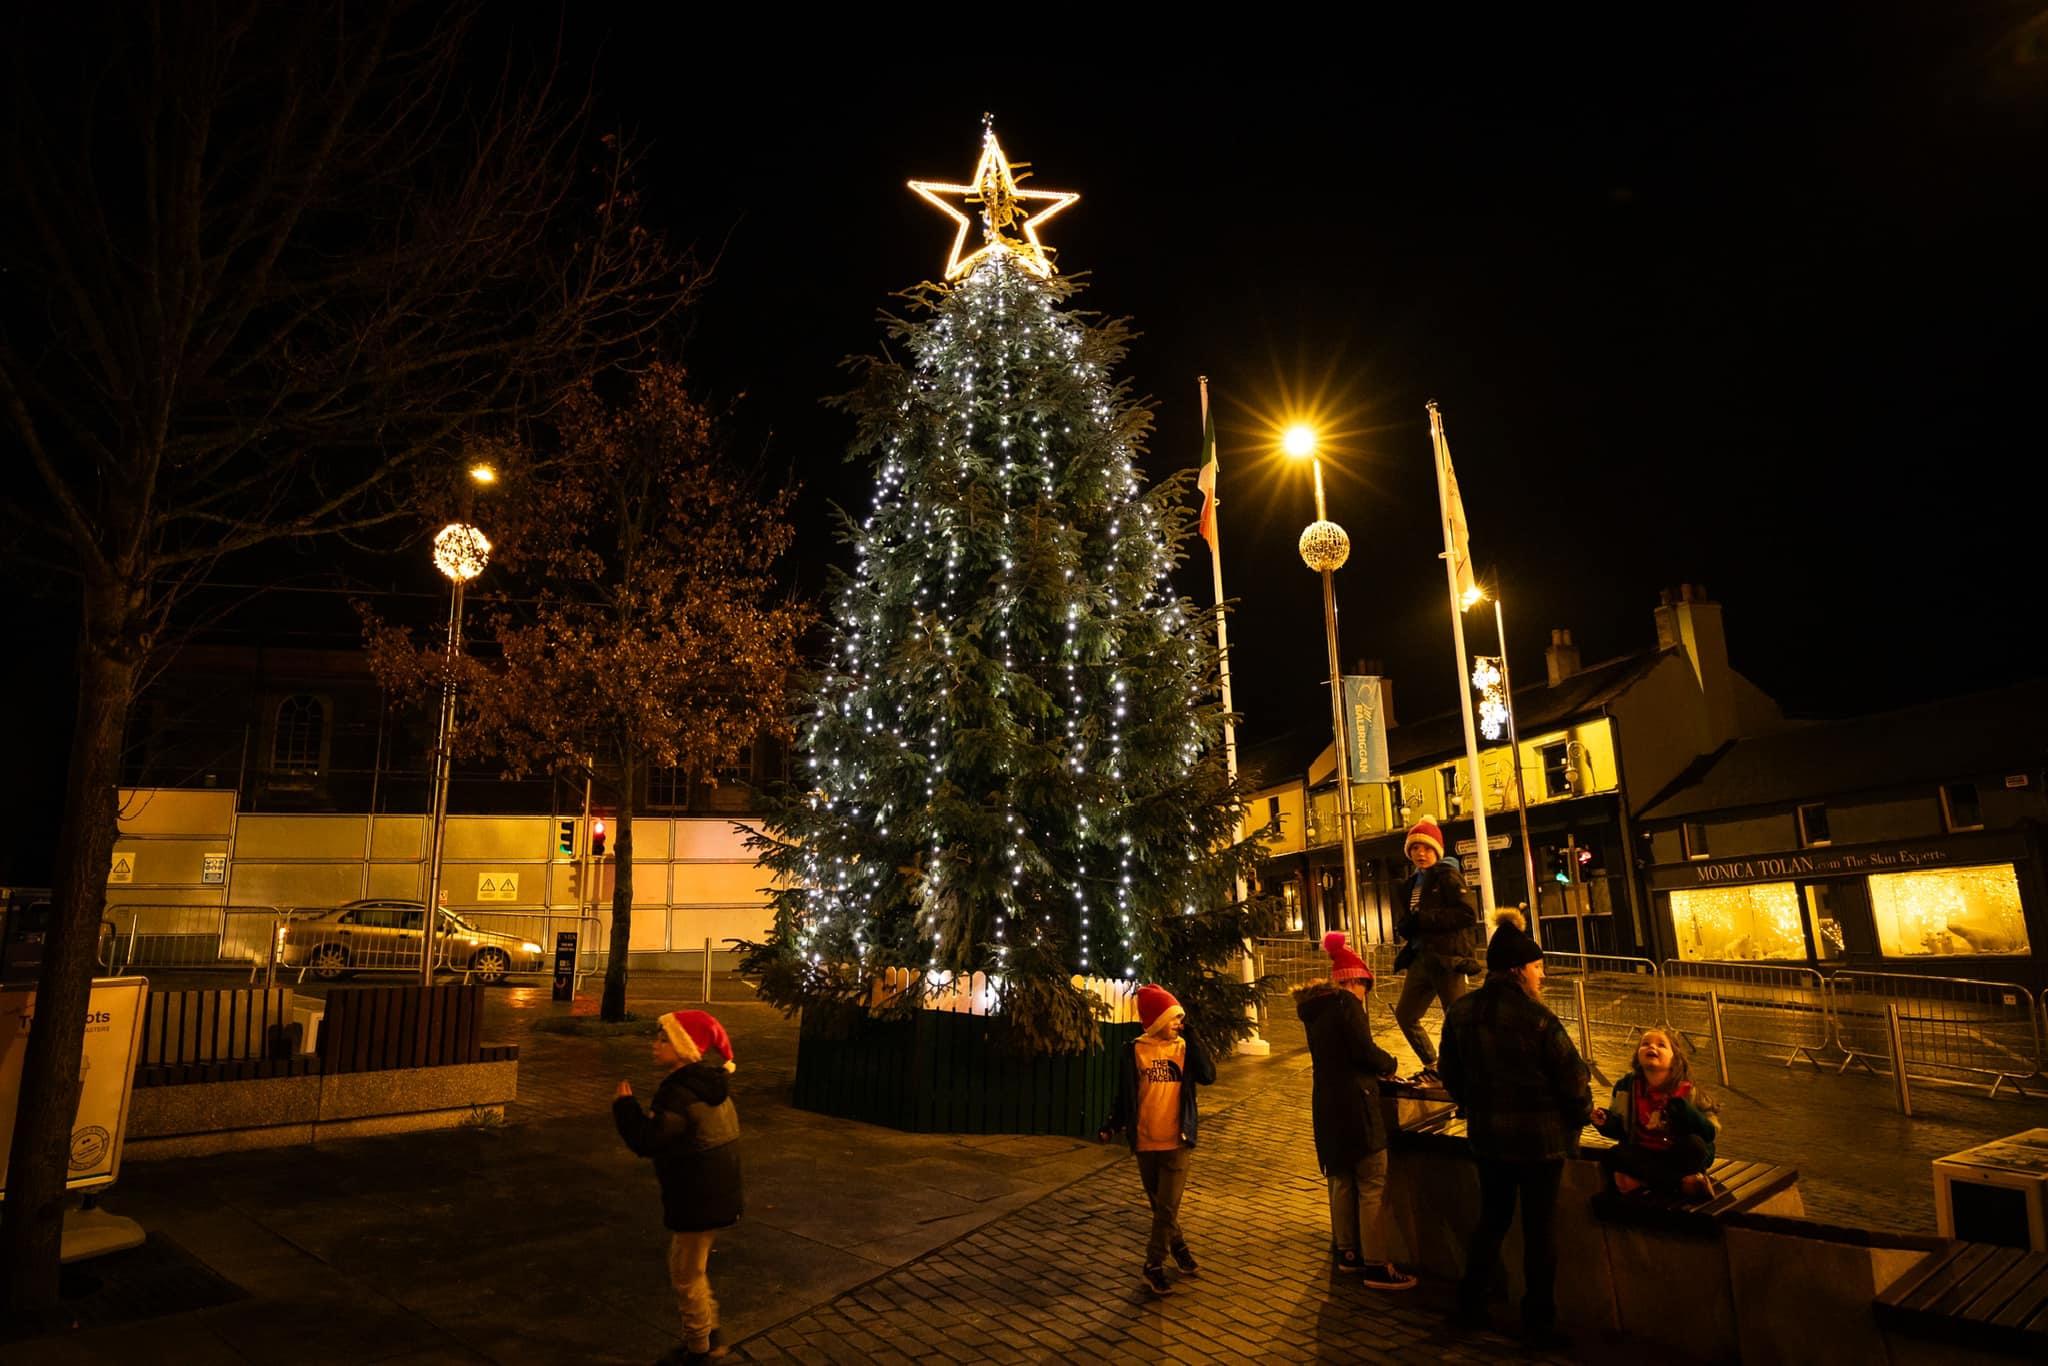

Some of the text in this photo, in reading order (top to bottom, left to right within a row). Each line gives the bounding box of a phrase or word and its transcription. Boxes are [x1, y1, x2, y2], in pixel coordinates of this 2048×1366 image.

[1354, 704, 1369, 773] BALBRIGGAN
[1696, 862, 1755, 882] MONICA
[1843, 855, 1868, 868] The
[1870, 852, 1896, 865] Skin
[1898, 849, 1946, 865] Experts
[1148, 1075, 1169, 1083] FACE
